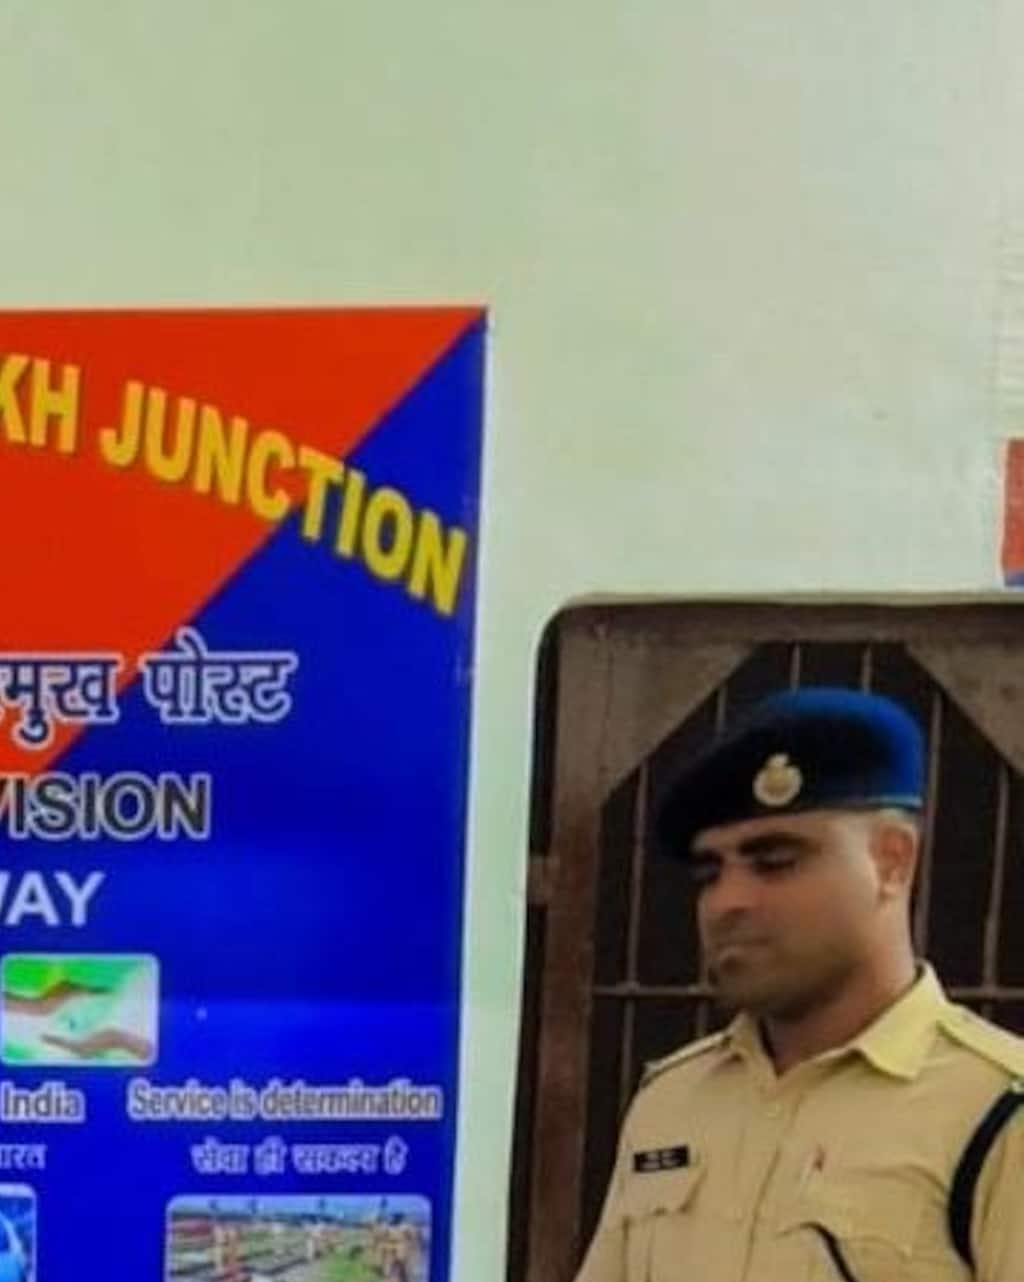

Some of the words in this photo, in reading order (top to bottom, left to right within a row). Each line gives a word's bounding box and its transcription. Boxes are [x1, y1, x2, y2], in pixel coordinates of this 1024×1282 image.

[99, 379, 470, 616] JUNCTION
[142, 627, 297, 725] पोस्ट
[0, 1081, 84, 1122] India
[129, 1078, 225, 1120] Service
[231, 1079, 256, 1120] is
[262, 1080, 441, 1120] determination
